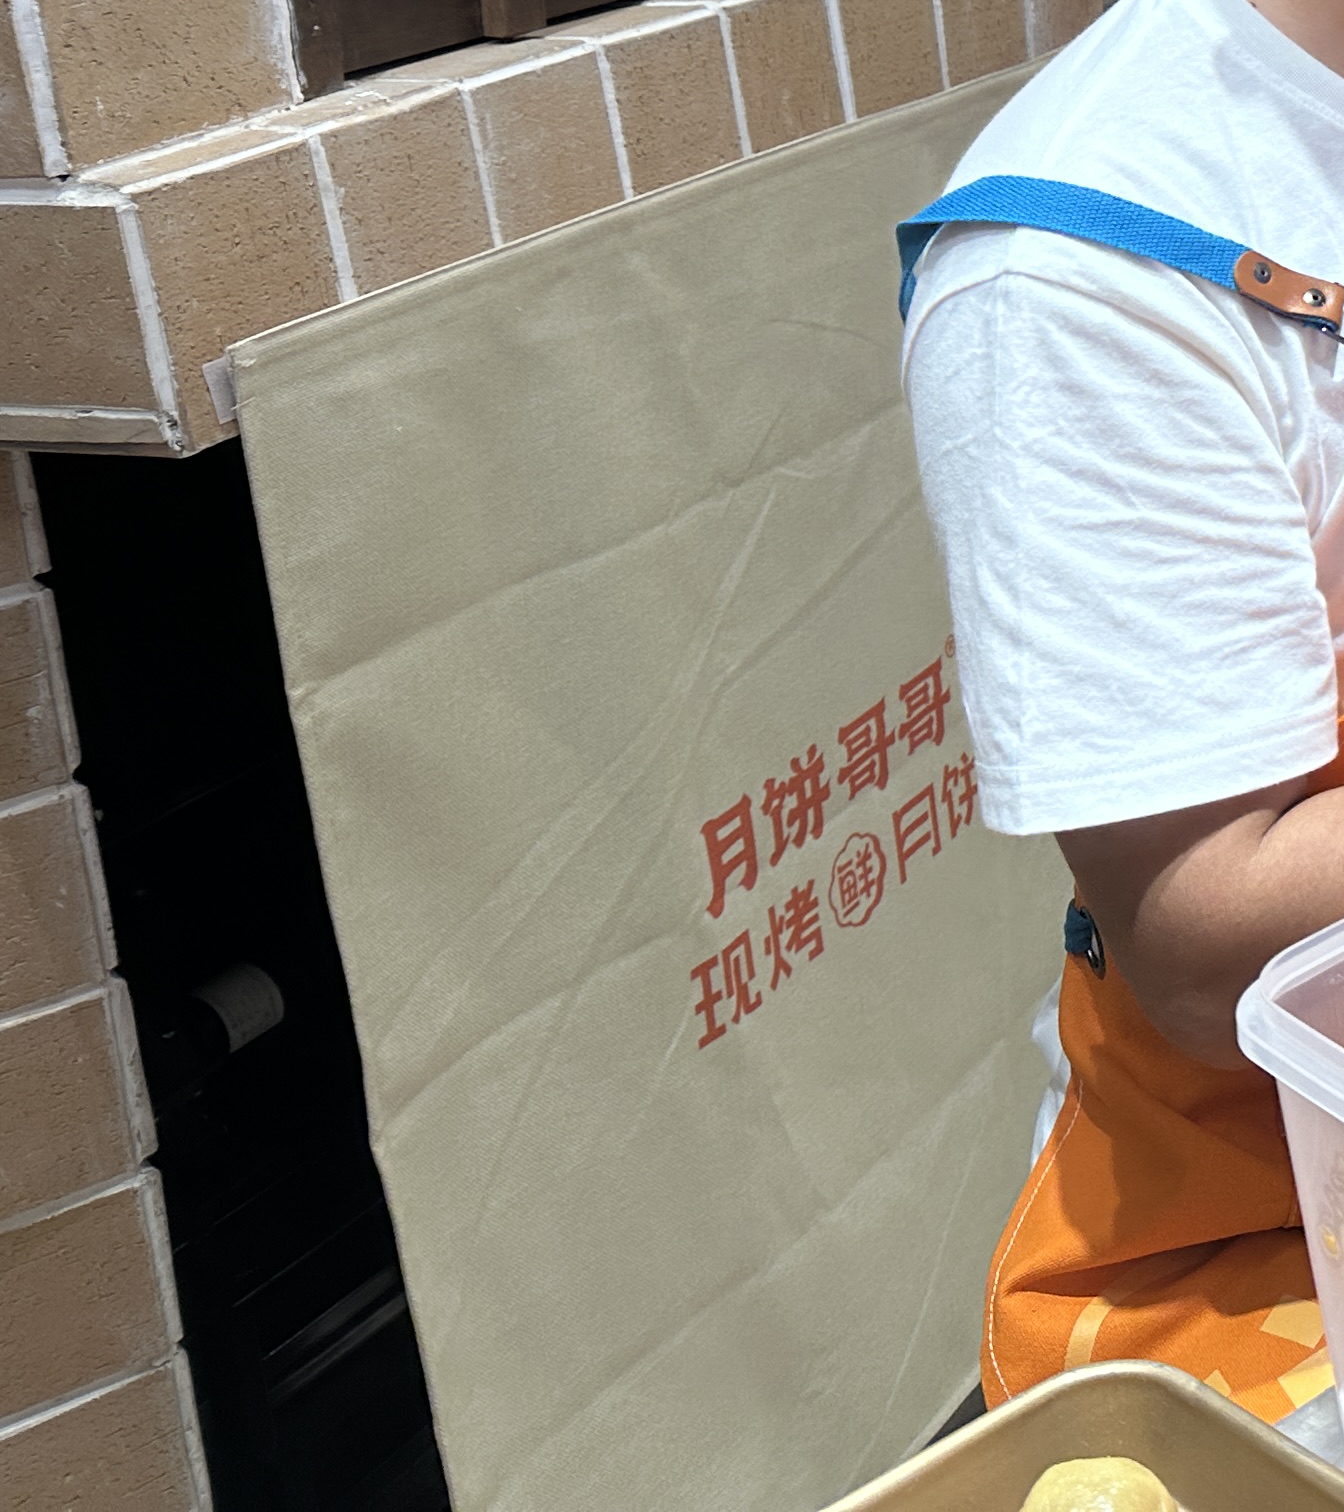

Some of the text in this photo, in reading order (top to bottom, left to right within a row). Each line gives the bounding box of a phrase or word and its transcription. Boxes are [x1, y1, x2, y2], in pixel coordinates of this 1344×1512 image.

[690, 751, 979, 1050] 现烤鲜月饼
[699, 656, 951, 920] 月饼哥哥
